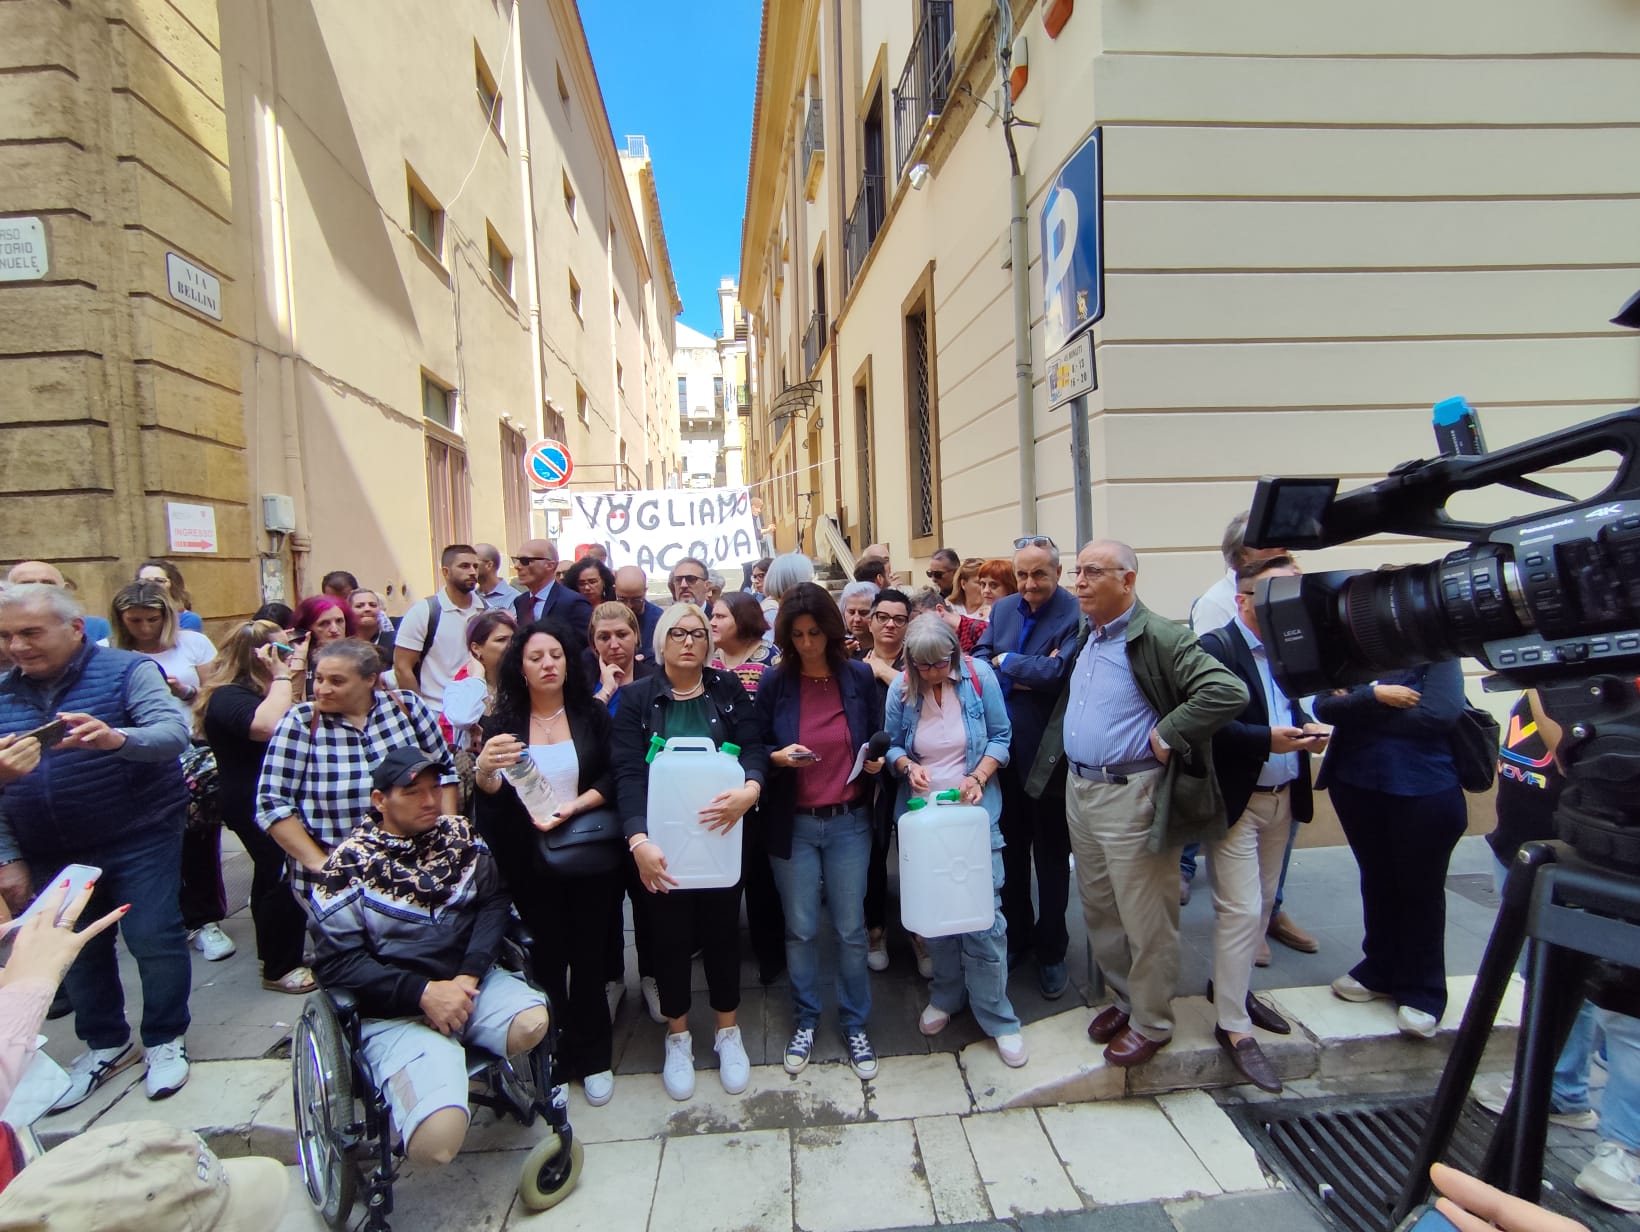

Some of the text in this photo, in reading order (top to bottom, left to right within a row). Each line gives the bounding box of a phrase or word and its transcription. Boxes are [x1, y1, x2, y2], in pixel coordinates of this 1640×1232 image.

[185, 268, 207, 290] VIA
[177, 280, 216, 311] BELLINI
[575, 491, 748, 535] VOGLIAMO
[1584, 503, 1624, 519] 4K
[174, 527, 214, 538] INGRESSO
